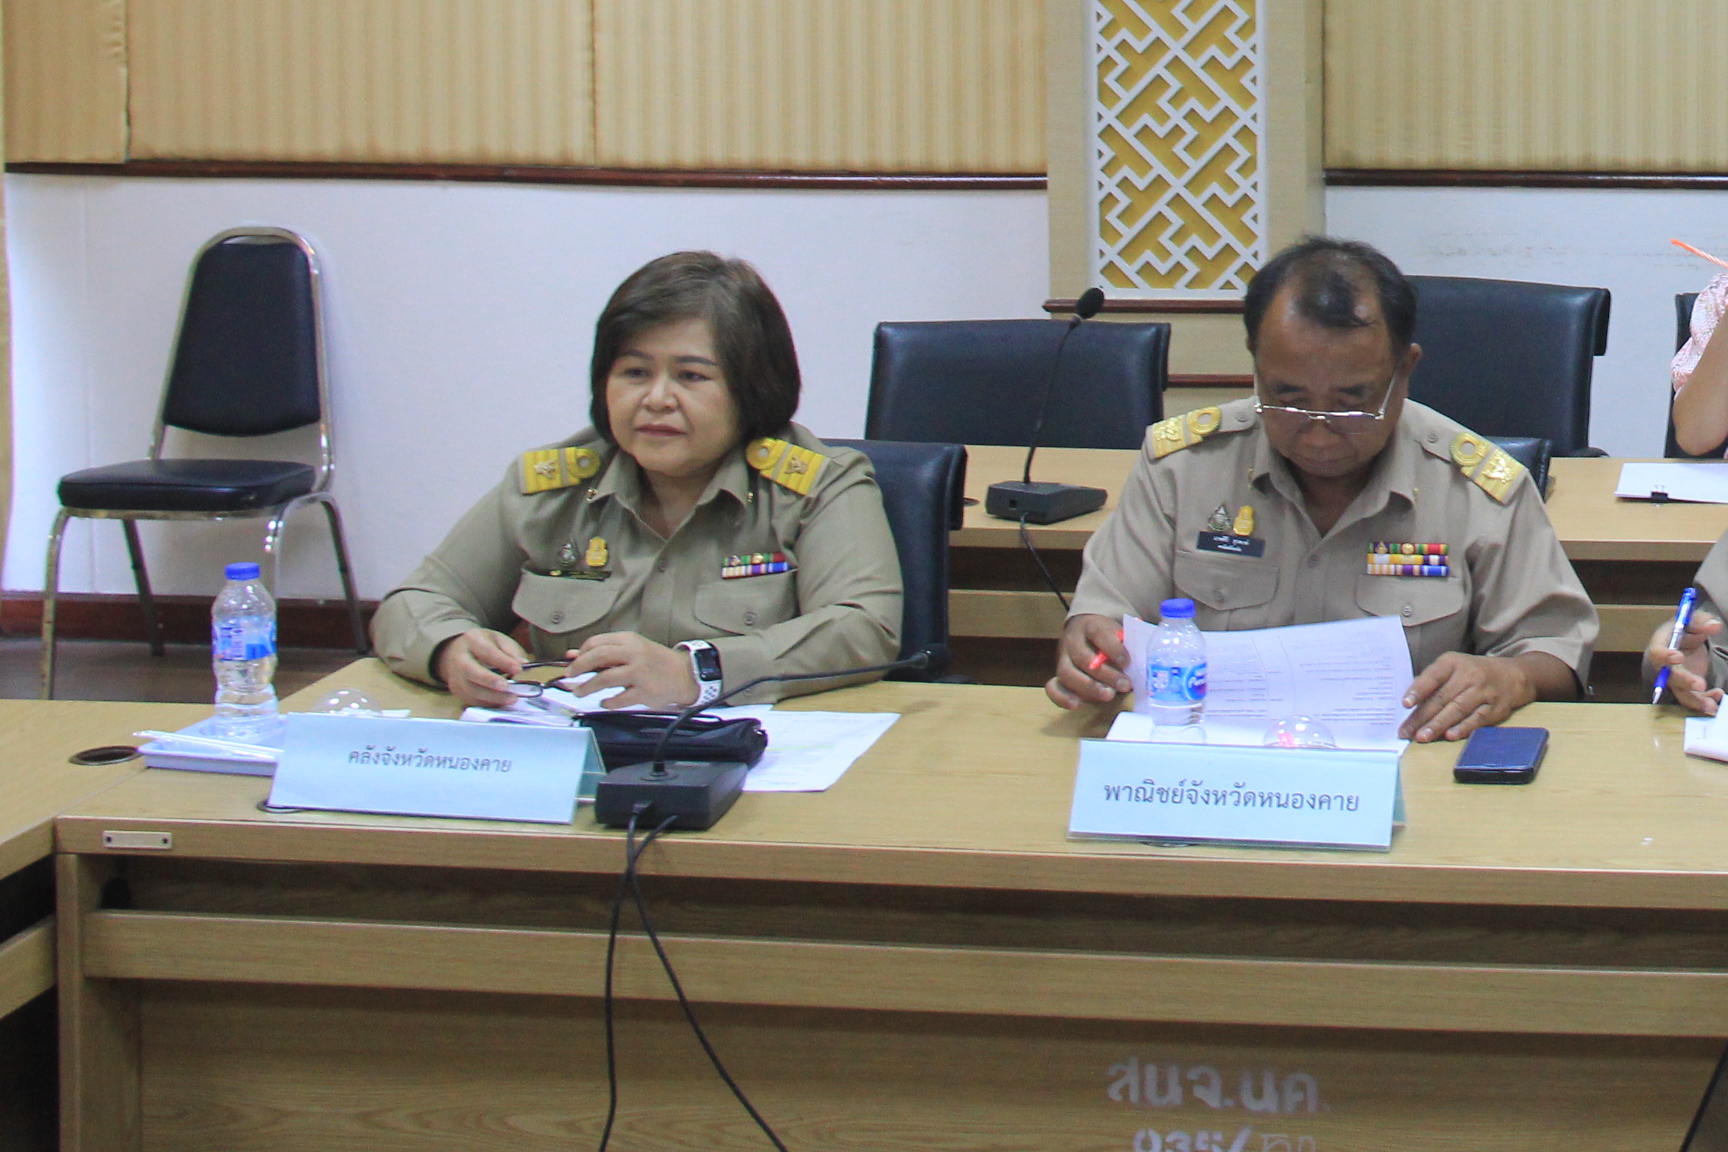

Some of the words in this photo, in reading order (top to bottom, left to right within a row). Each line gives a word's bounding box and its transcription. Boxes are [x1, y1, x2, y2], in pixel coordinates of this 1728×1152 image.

[347, 744, 513, 773] คลังจังหวัดหนองคาย
[1103, 778, 1360, 812] พาณิชย์จังหวัดหนองคาย
